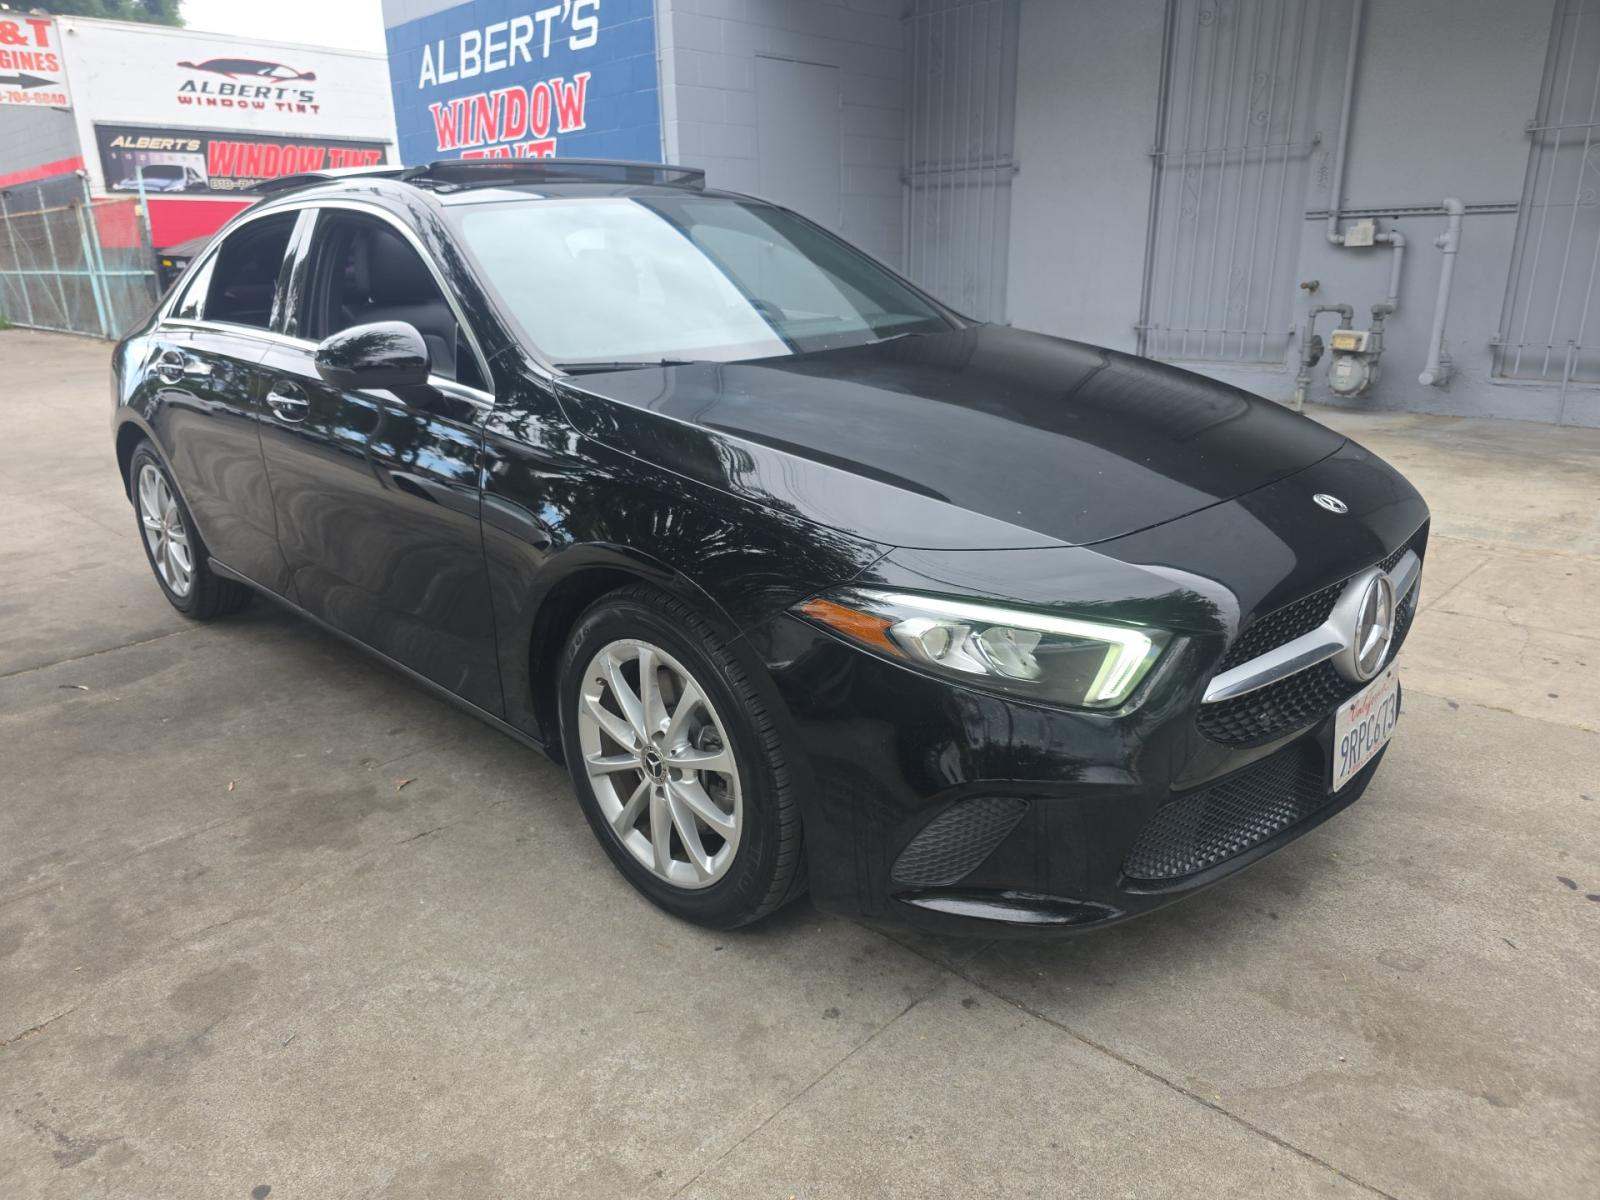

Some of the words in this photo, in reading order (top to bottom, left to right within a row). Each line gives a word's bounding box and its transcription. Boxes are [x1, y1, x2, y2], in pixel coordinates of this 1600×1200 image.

[417, 0, 601, 90] ALBERT'S
[176, 95, 265, 111] WINDOW
[275, 102, 321, 115] TINT
[178, 79, 316, 103] ALBERT'S
[428, 71, 592, 153] WINDOW
[109, 135, 201, 151] ALBERT'S
[207, 140, 326, 179] WINDOW
[327, 147, 382, 169] TINT
[1339, 692, 1396, 778] 9RPC673
